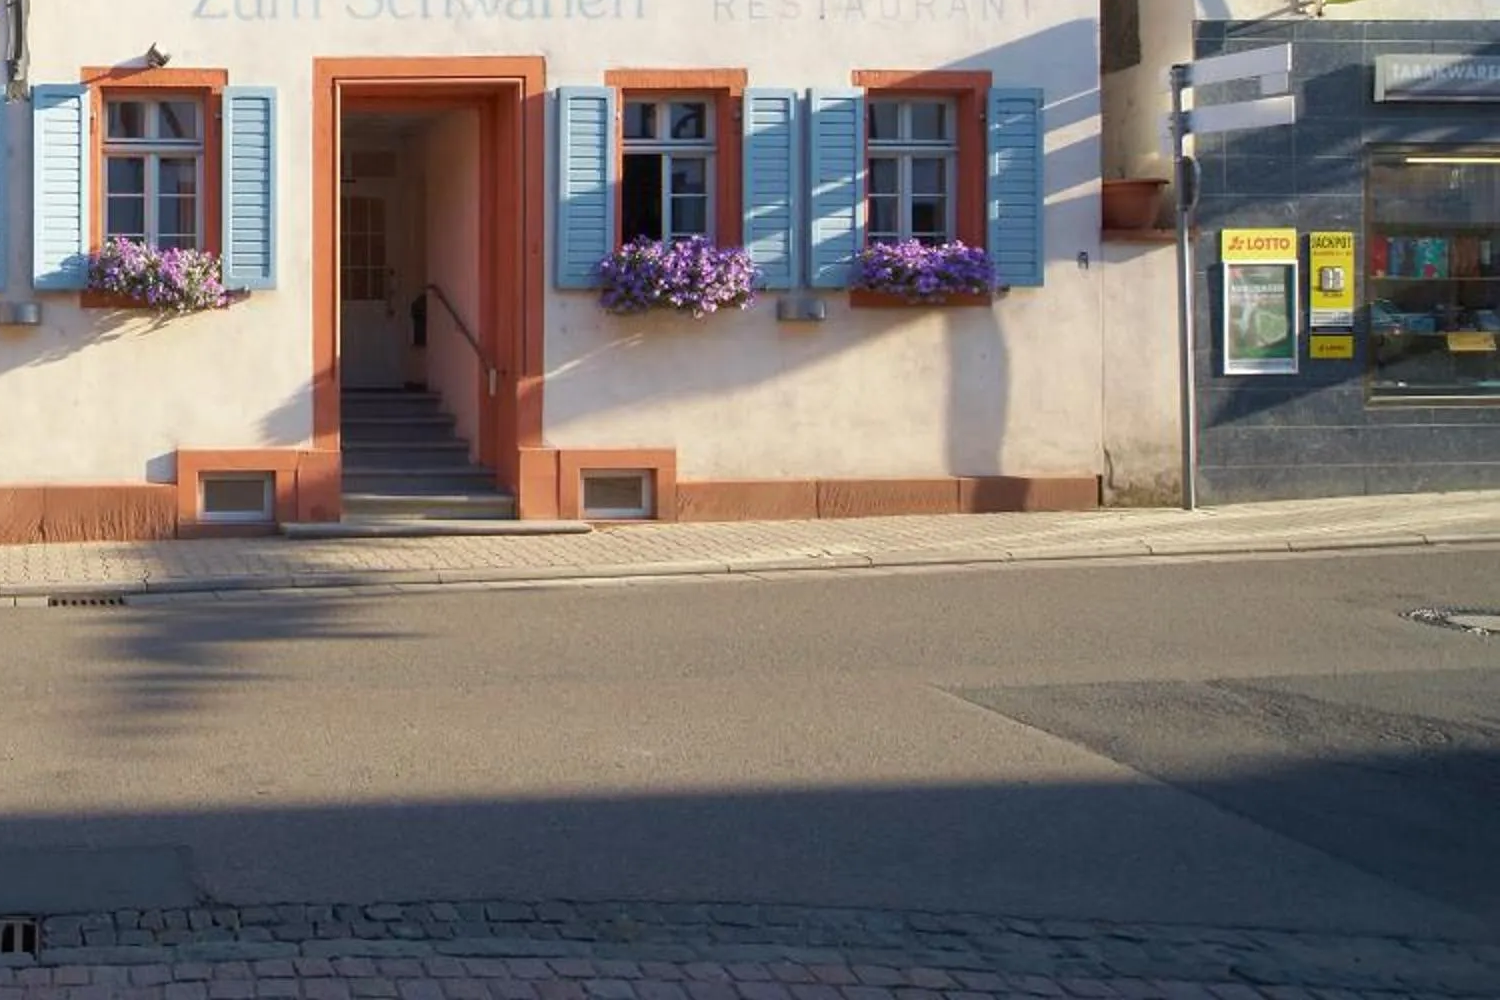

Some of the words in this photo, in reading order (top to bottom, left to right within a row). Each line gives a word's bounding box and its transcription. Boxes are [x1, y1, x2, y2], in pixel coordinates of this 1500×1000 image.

[1392, 63, 1500, 80] TABAKWARE
[1247, 237, 1291, 250] LOTTO
[1311, 234, 1353, 249] JACKPOT
